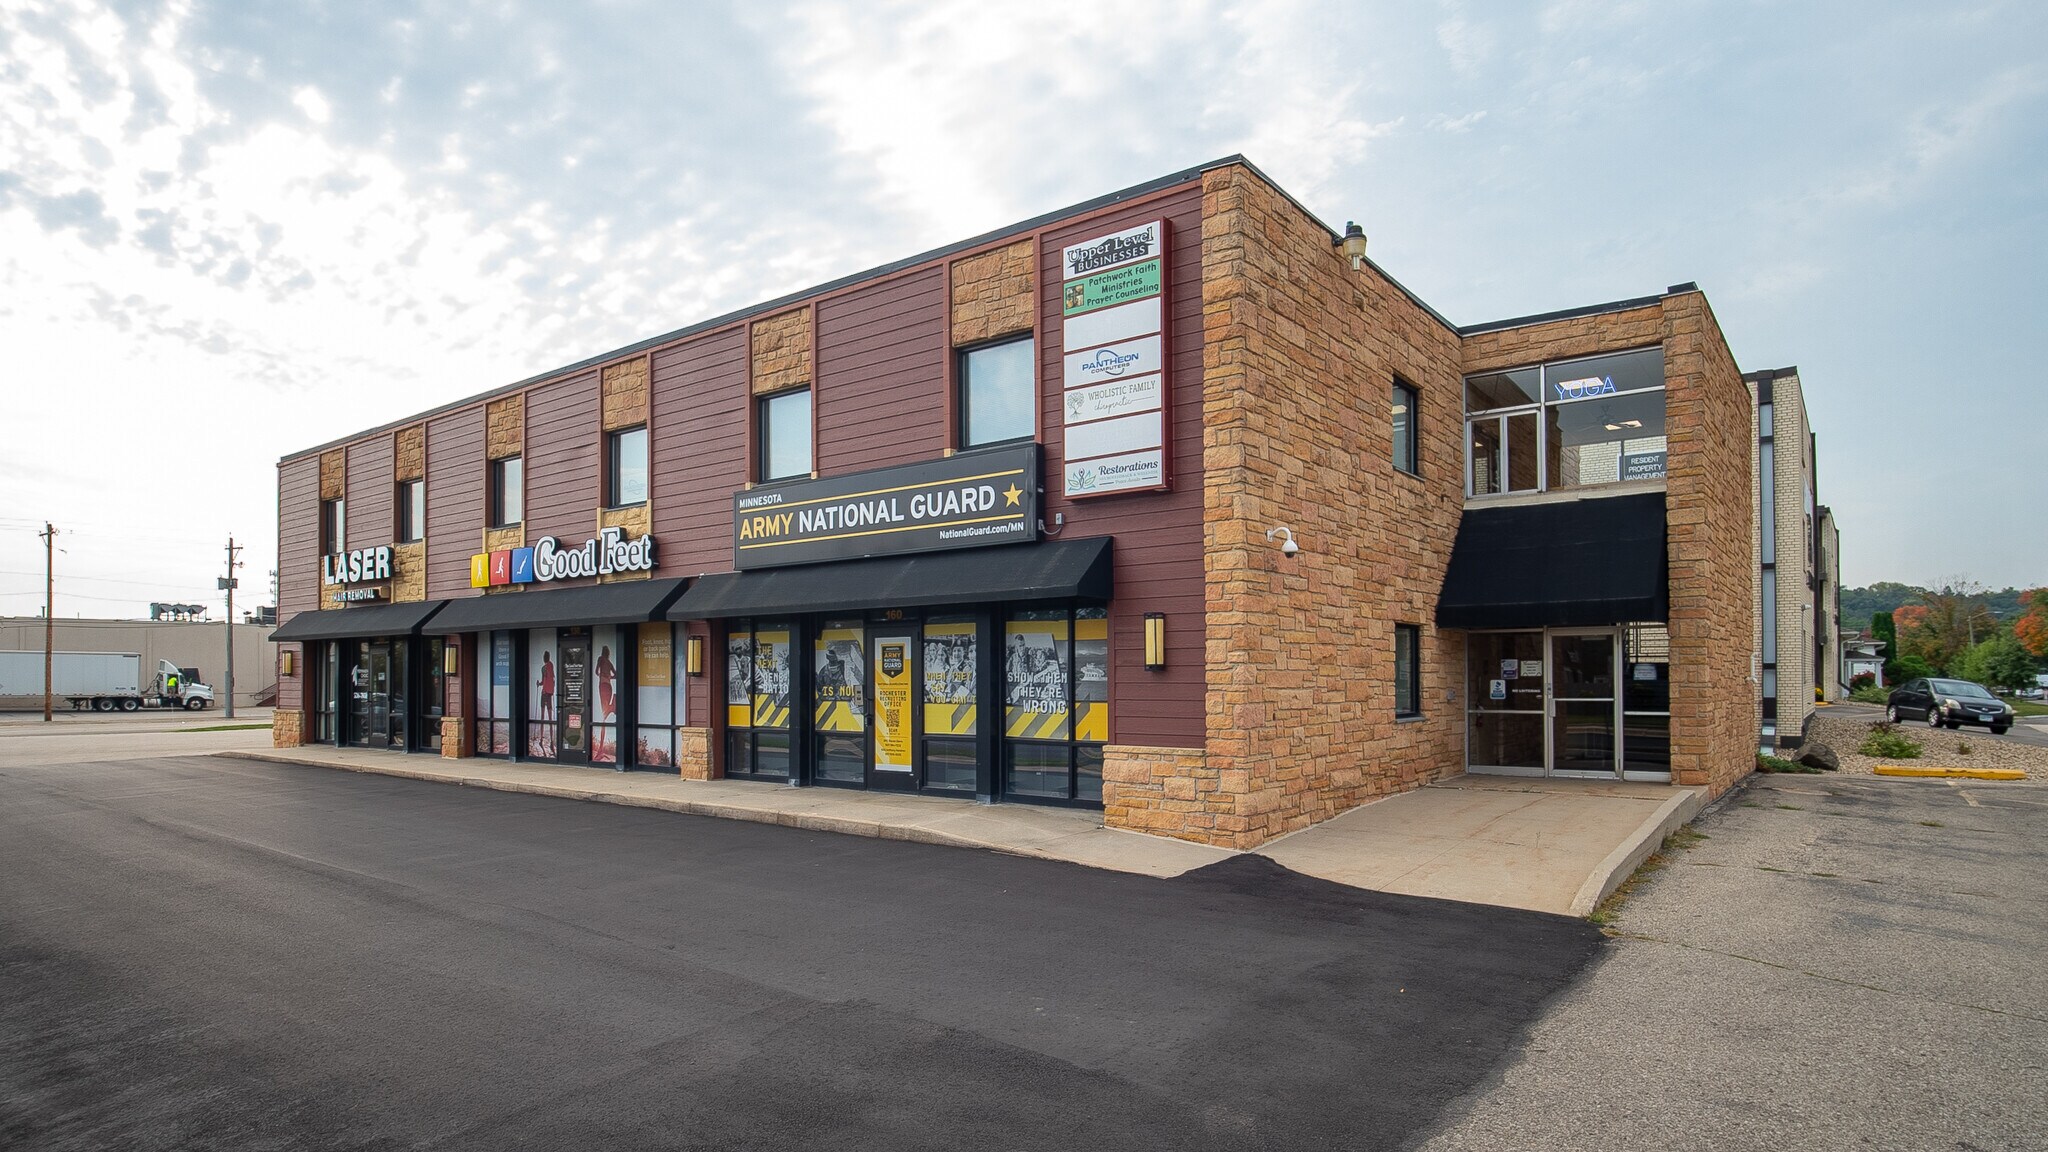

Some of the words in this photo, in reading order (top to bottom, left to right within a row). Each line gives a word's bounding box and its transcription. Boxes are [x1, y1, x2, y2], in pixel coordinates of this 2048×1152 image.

[1067, 244, 1111, 263] Upper
[1114, 226, 1154, 250] Level
[1078, 245, 1145, 272] BUSINESSES
[1089, 269, 1133, 287] Patchwork
[1135, 263, 1157, 275] Faith
[1086, 294, 1114, 306] Prayer
[1115, 283, 1159, 299] Counseling
[1101, 277, 1143, 294] Ministries
[1082, 353, 1139, 371] PANTHEON
[1091, 362, 1131, 374] COMPUTERS
[1088, 385, 1127, 401] WHOLISTIC
[1129, 380, 1156, 394] FAMILY
[1554, 375, 1617, 400] YOGA
[1094, 395, 1133, 415] chiropractic
[1098, 460, 1158, 476] Restorations
[1628, 463, 1663, 473] PROPERTY
[1631, 455, 1660, 464] RESIDENT
[739, 493, 783, 508] MINNESOTA
[739, 512, 794, 540] ARMY
[799, 498, 905, 533] NATIONAL
[910, 485, 996, 519] GUARD
[939, 521, 1024, 540] NationalGuard.com/MN
[534, 535, 597, 582] Good
[599, 526, 652, 575] Feet
[323, 545, 390, 585] LASER
[347, 588, 375, 601] REMOVAL
[1007, 671, 1034, 683] SHOW
[1041, 672, 1068, 684] THEM
[822, 686, 834, 697] IS
[1023, 699, 1067, 714] WRONG
